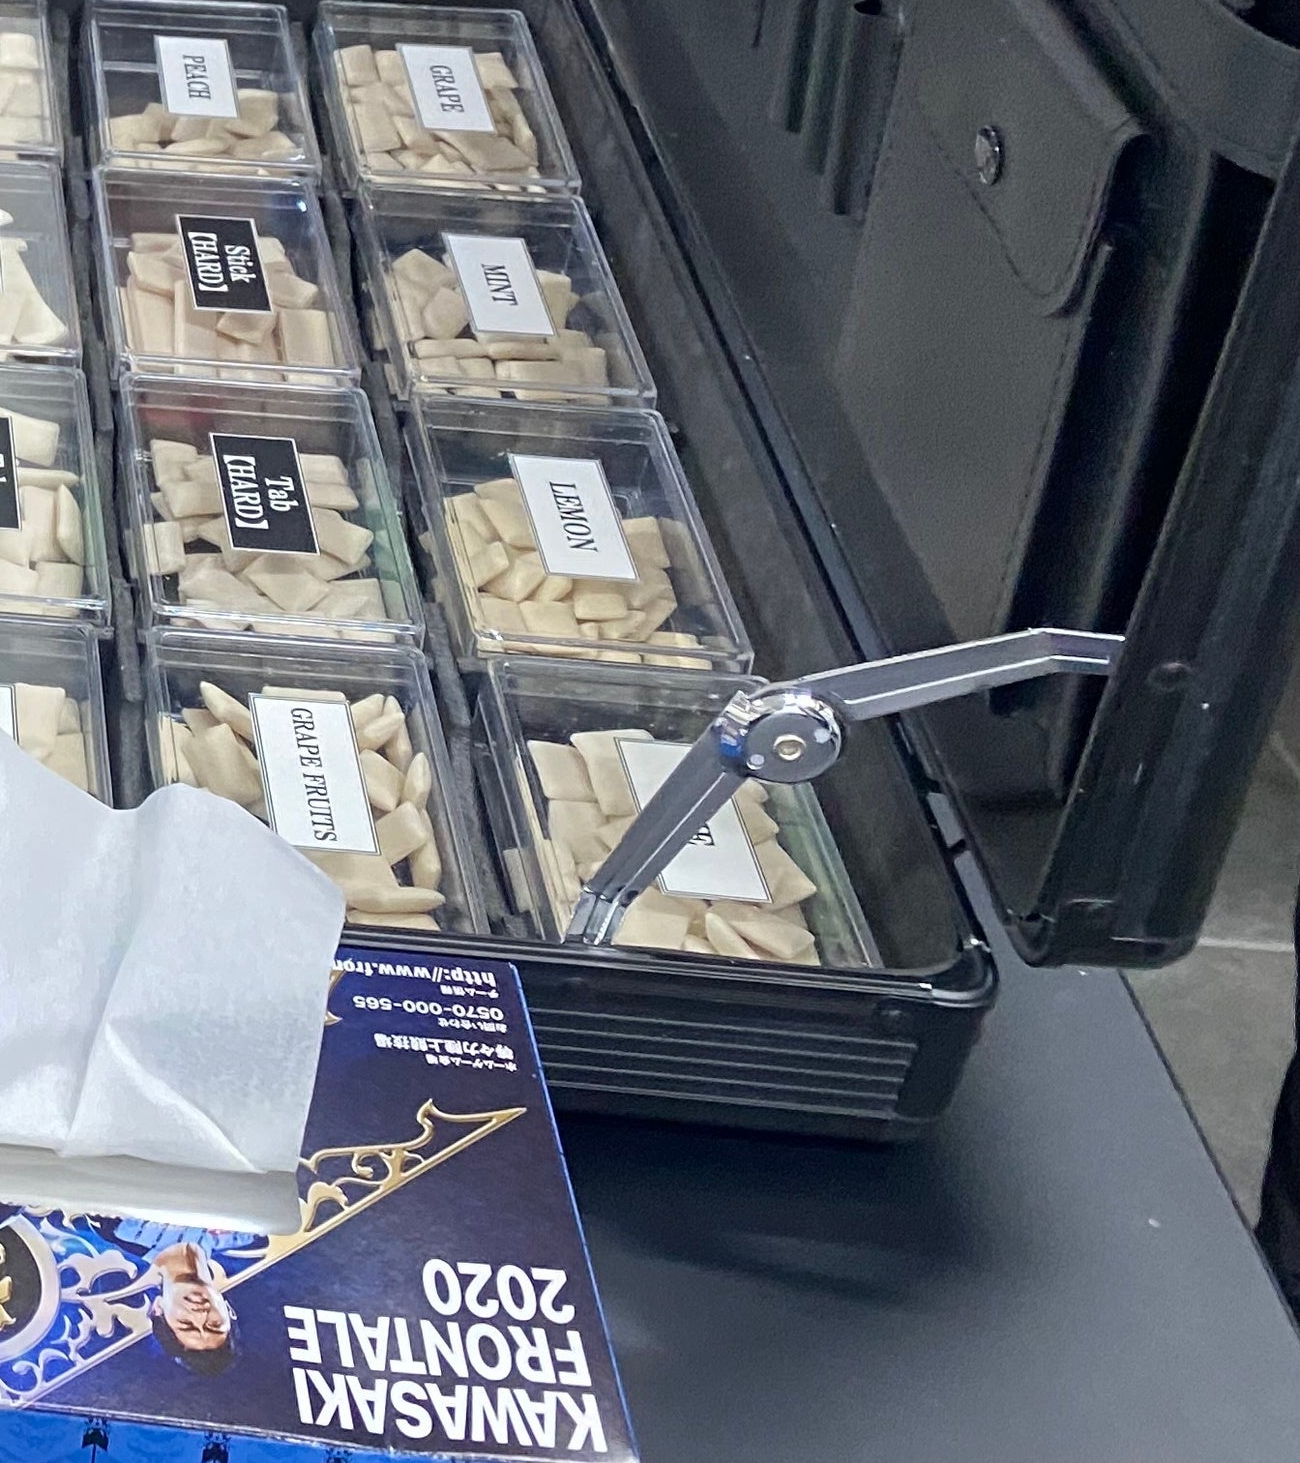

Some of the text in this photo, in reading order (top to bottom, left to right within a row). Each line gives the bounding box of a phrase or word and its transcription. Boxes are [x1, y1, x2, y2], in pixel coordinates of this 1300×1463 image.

[184, 54, 213, 100] PEACH
[430, 65, 463, 114] GRAPE
[226, 246, 256, 284] Stick
[483, 265, 518, 306] MINT
[266, 476, 299, 512] Tab
[550, 482, 597, 552] LEMON
[291, 707, 338, 842] GRAPE FRUITS
[352, 995, 504, 1021] 0570-000-565
[422, 1258, 577, 1324] 2020
[283, 1306, 591, 1387] FRONTALE
[292, 1368, 608, 1452] KAWASAKI
